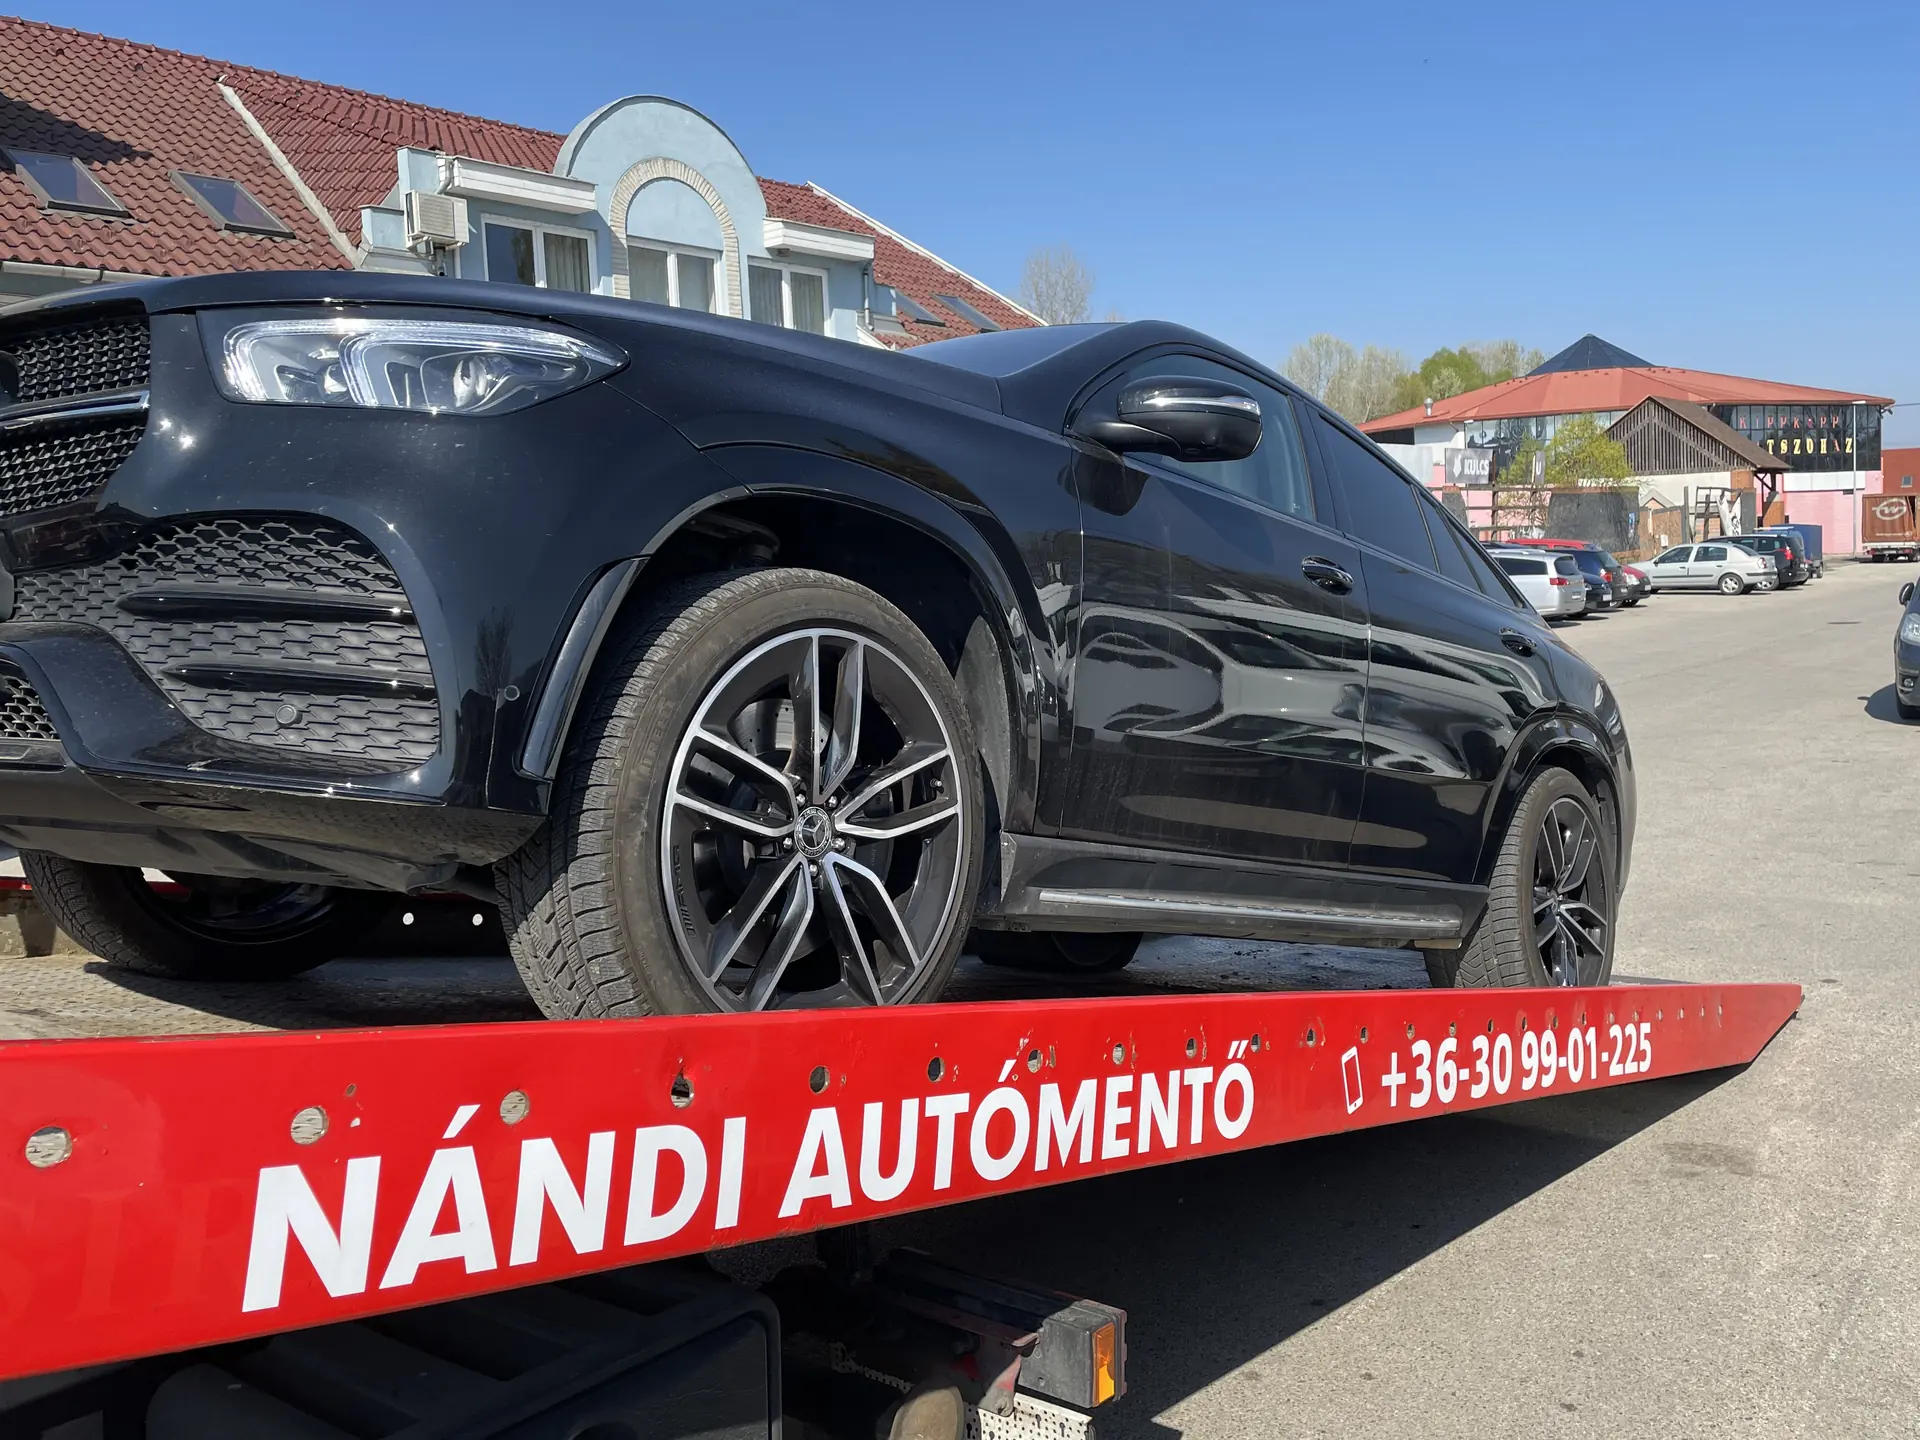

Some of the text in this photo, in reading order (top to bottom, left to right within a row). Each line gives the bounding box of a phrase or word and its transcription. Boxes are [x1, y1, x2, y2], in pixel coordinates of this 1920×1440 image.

[1463, 458, 1490, 476] KULCS
[1381, 1022, 1652, 1109] +36-30 99-01-225
[242, 1104, 747, 1313] NÁNDI
[777, 1039, 1255, 1219] AUTÓMENTŐ
